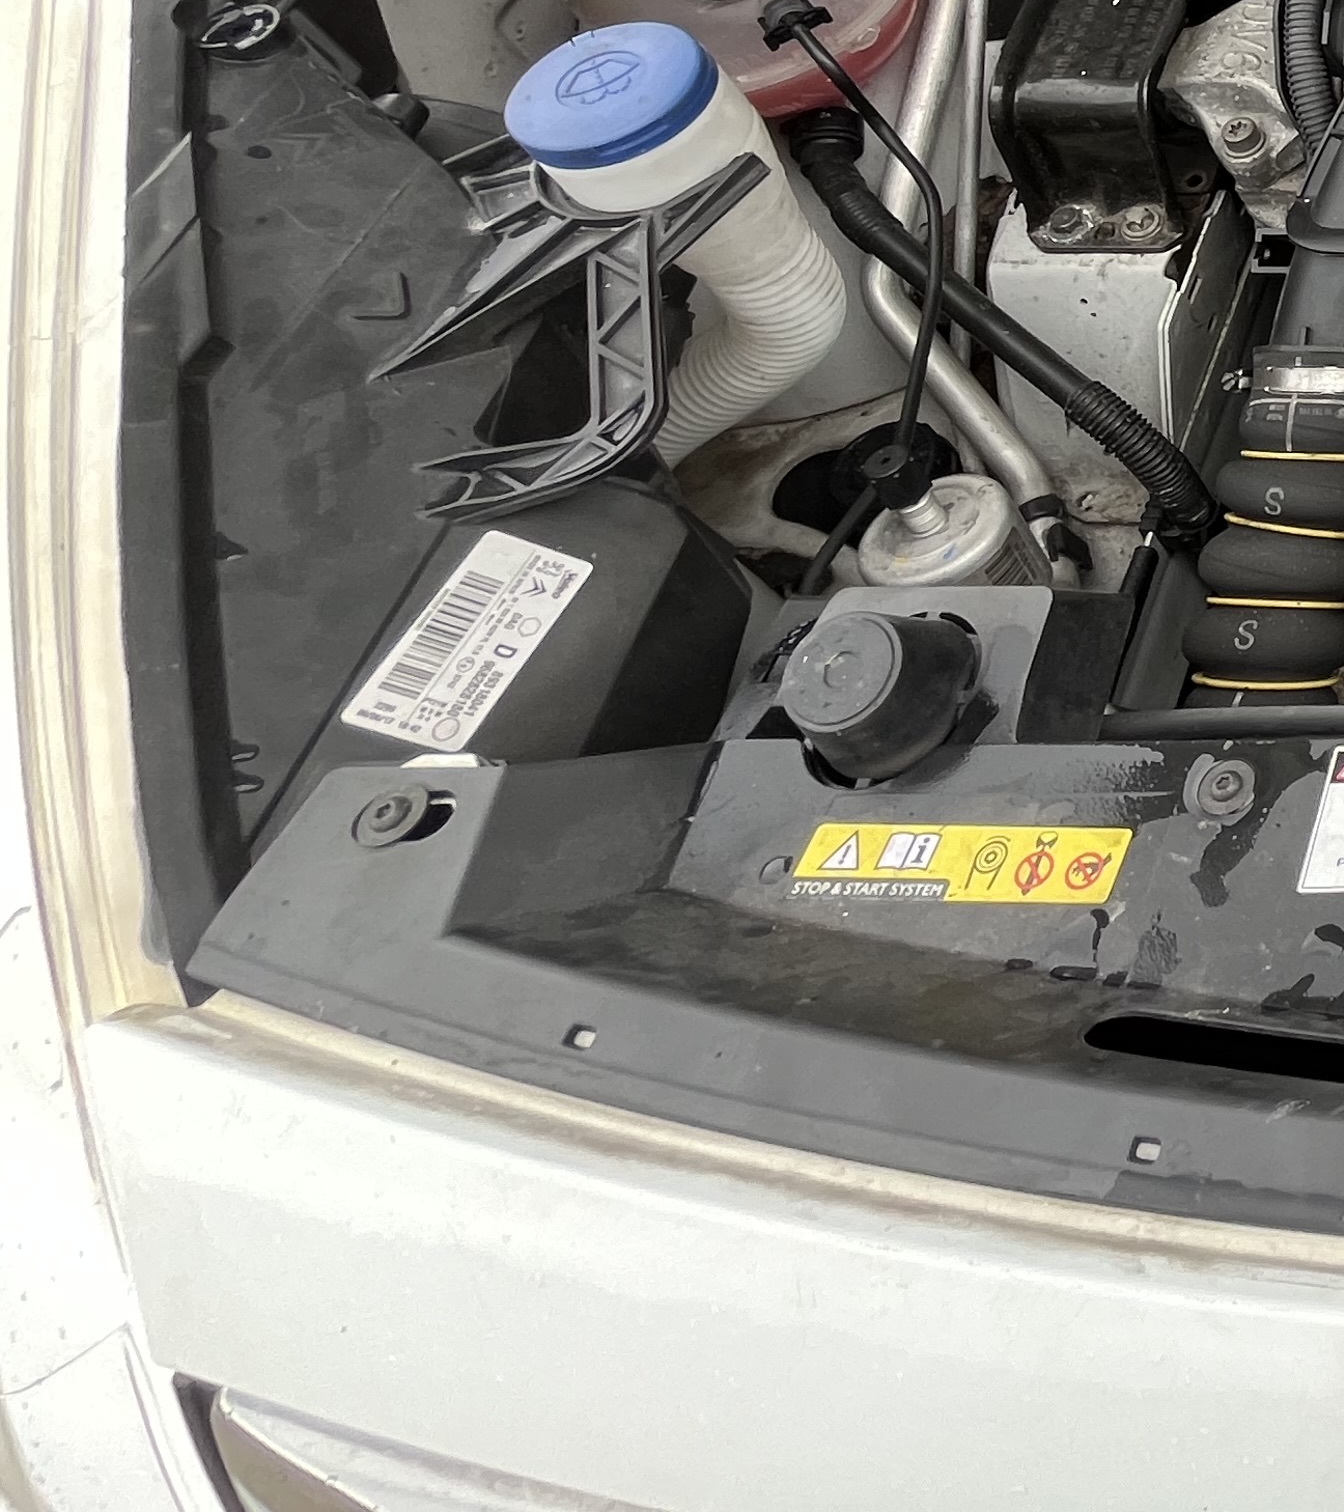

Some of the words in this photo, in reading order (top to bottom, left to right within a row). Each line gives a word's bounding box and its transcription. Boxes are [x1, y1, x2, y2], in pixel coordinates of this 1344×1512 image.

[1264, 488, 1286, 517] S
[1233, 619, 1256, 652] S
[494, 642, 518, 659] D
[791, 882, 831, 894] STOP
[831, 883, 843, 895] &
[843, 883, 888, 895] START
[889, 883, 944, 896] SYSTEM
